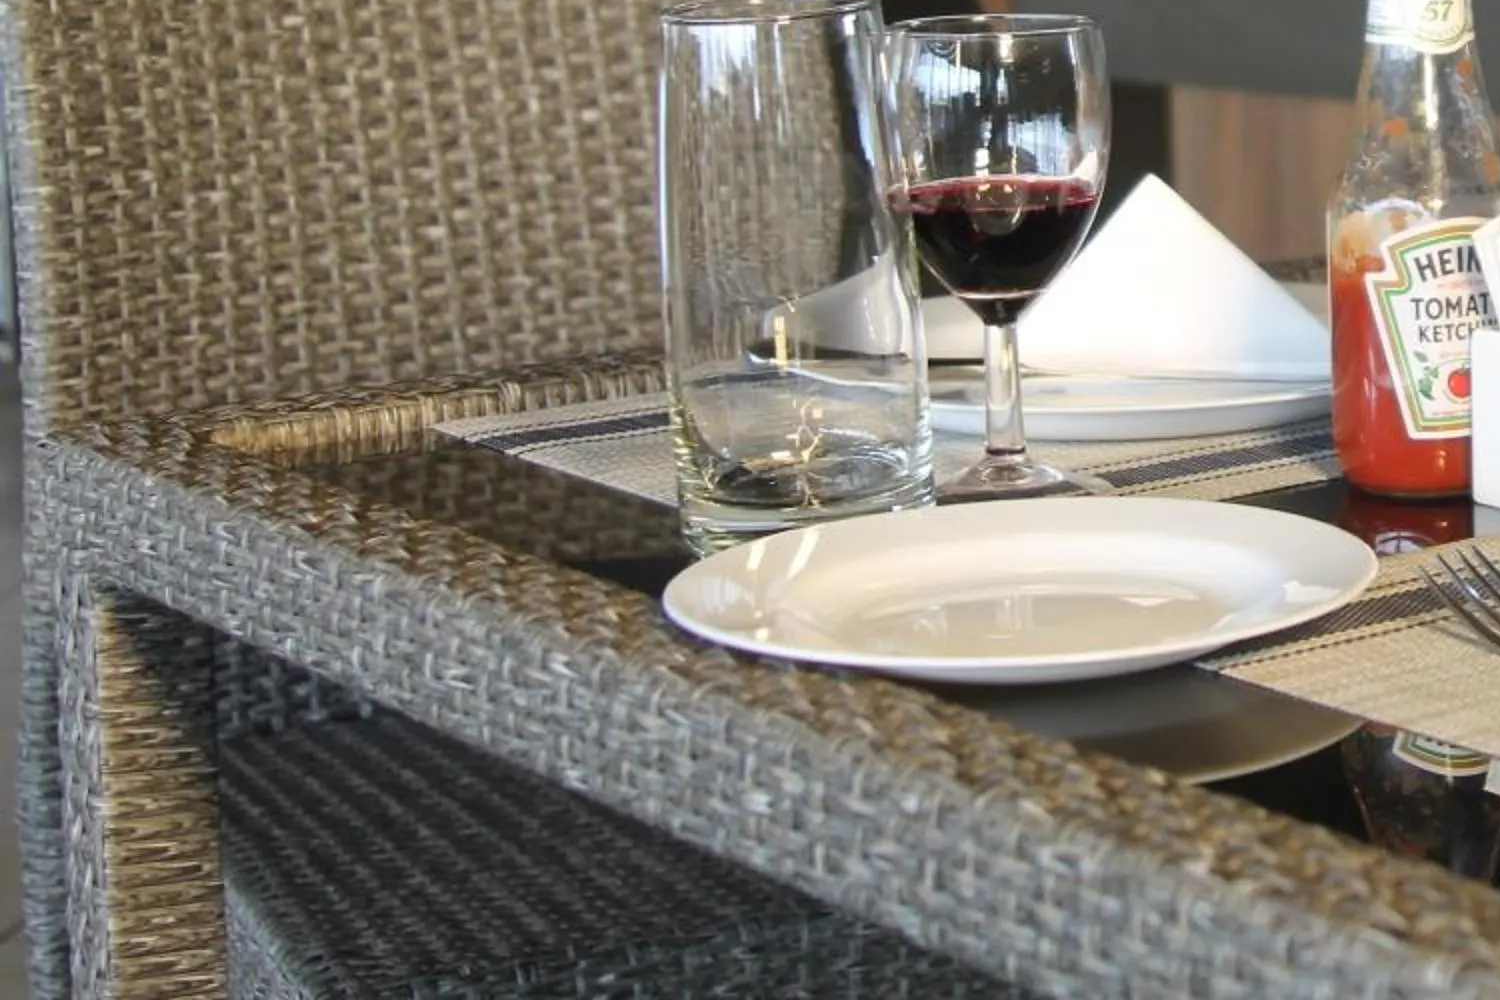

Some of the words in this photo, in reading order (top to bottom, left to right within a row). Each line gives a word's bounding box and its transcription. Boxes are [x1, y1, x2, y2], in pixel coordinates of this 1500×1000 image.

[1422, 0, 1454, 21] 57
[1414, 246, 1483, 282] HEIN
[1410, 291, 1490, 321] TOMAT
